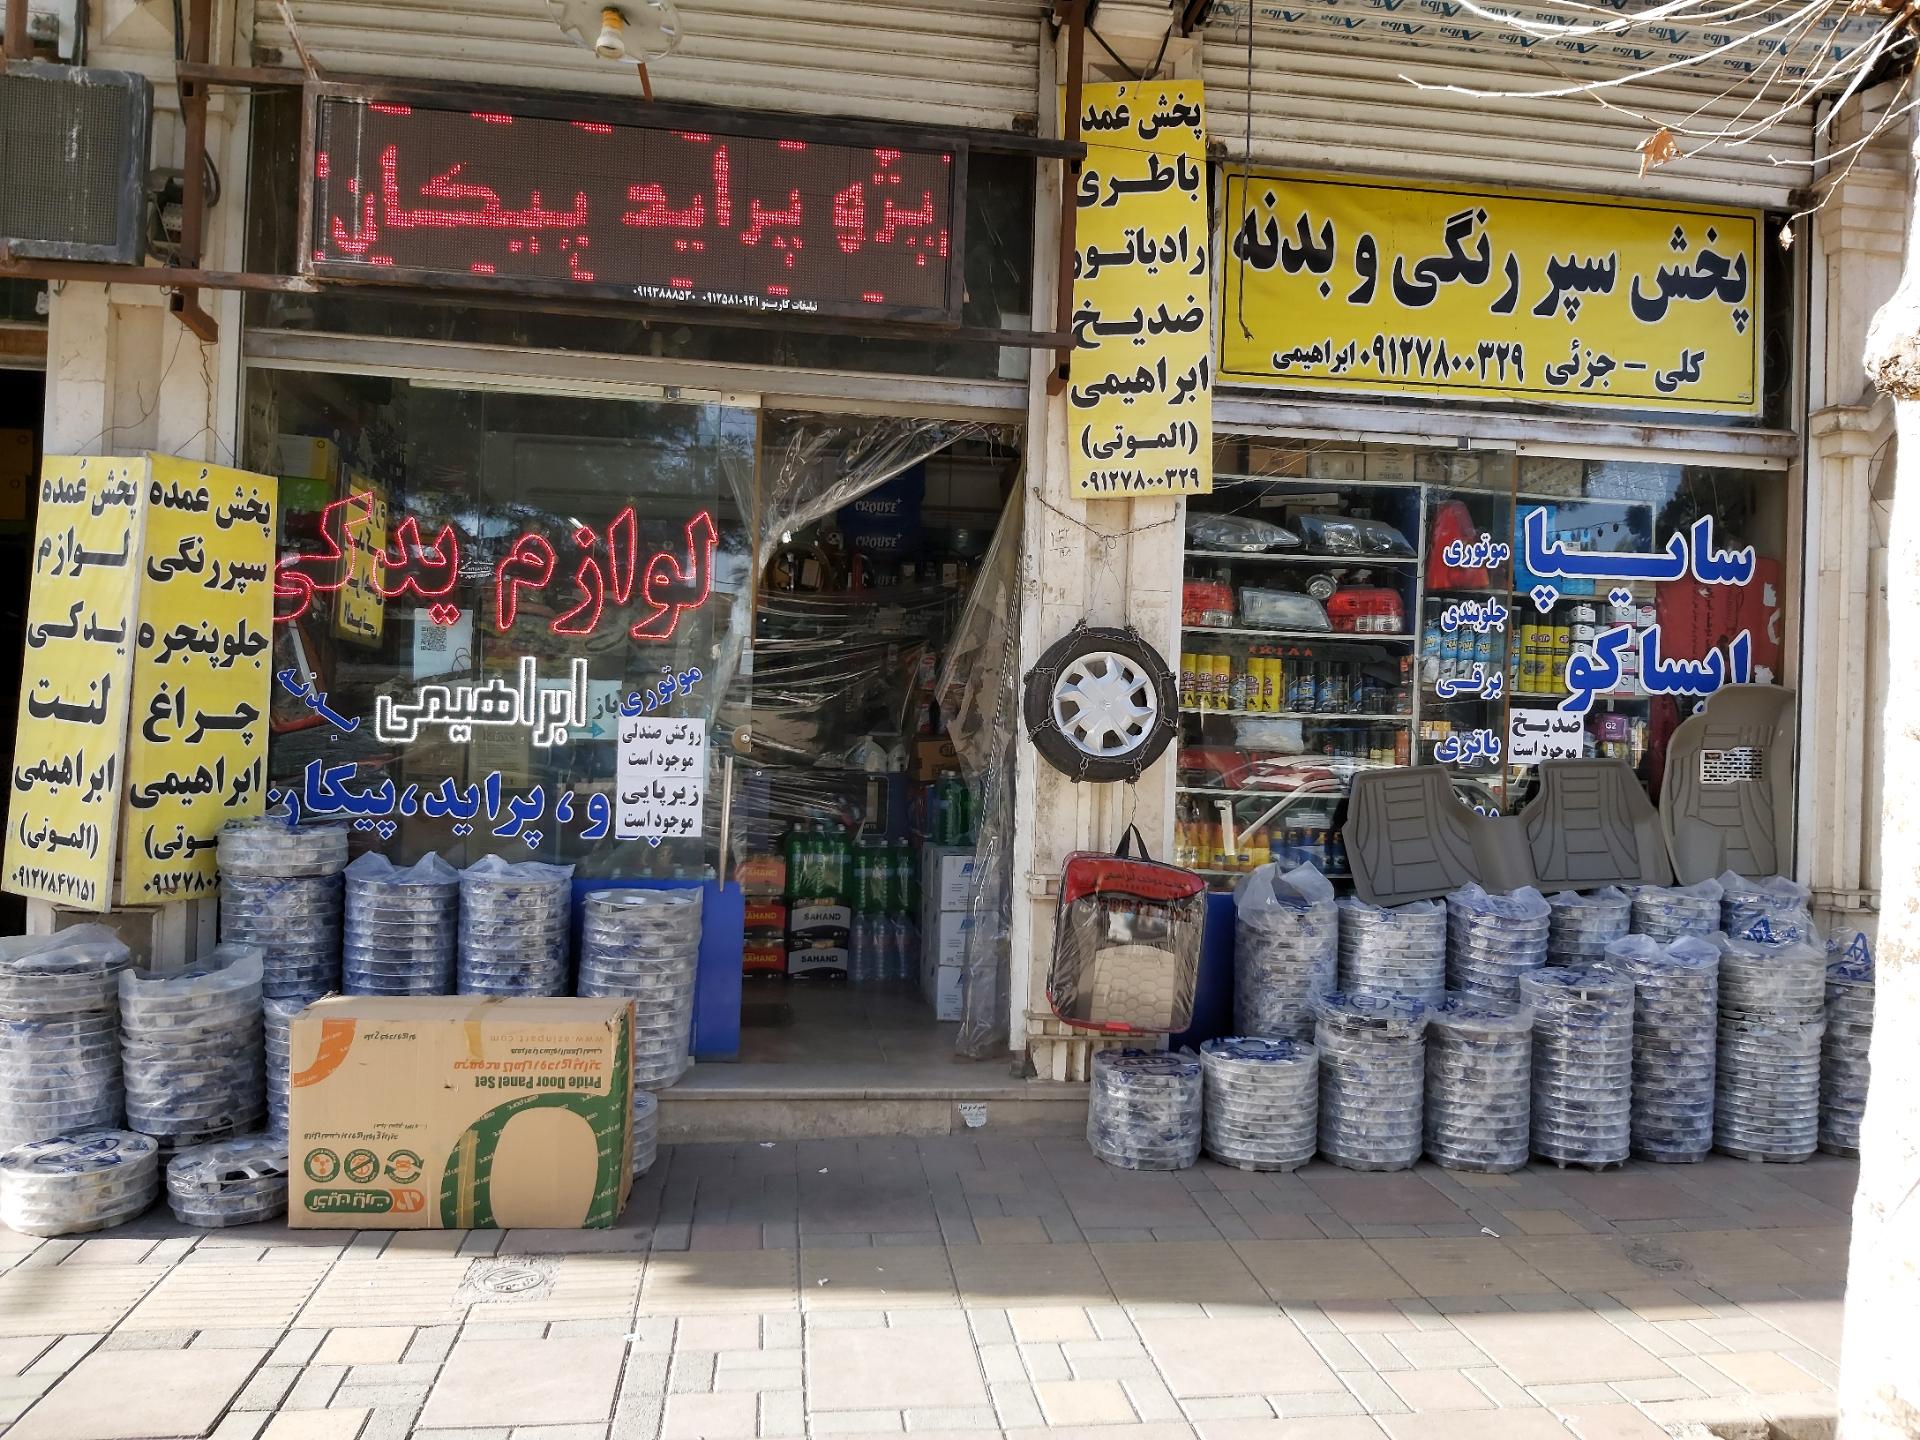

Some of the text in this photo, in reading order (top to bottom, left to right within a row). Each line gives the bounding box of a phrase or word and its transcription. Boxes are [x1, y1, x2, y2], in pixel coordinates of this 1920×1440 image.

[1261, 9, 1306, 22] Alba
[1320, 14, 1366, 28] Alba
[1380, 20, 1425, 34] Alba
[1439, 26, 1484, 41] Alba
[1498, 33, 1542, 47] Alba
[1555, 39, 1599, 53] Alba
[1612, 46, 1655, 60] Alba
[1138, 93, 1203, 140] پخش
[1233, 191, 1750, 334] پخش سپر رنگی و بدنه
[1071, 294, 1205, 349] ضدیخ
[1272, 339, 1356, 373] ابراهیمی
[1654, 349, 1705, 393] کلی
[1070, 354, 1209, 408] ابراهیمی
[91, 469, 138, 519] پخش
[215, 486, 272, 538] پخش
[36, 526, 131, 577] لوازم
[1443, 533, 1510, 568] موتوری
[1524, 506, 1756, 614] سایپا
[220, 561, 268, 594] سپر
[496, 505, 720, 639] لوازم
[27, 601, 127, 656] یدکی
[28, 672, 112, 726] لنت
[620, 665, 703, 718] موتوری
[1436, 662, 1504, 700] برقی
[142, 681, 261, 746] چراغ
[375, 655, 588, 748] ابراهیمی
[622, 723, 702, 746] روکش صندلی
[1511, 713, 1582, 738] ضدیخ
[628, 749, 694, 771] موجود است
[1434, 728, 1502, 765] باتری
[1512, 740, 1578, 759] موجود است
[14, 747, 117, 804] ابراهیمی
[130, 755, 262, 809] ابراهیمی
[624, 810, 694, 835] موجود است
[474, 1076, 603, 1089] Pride Door Panel Set
